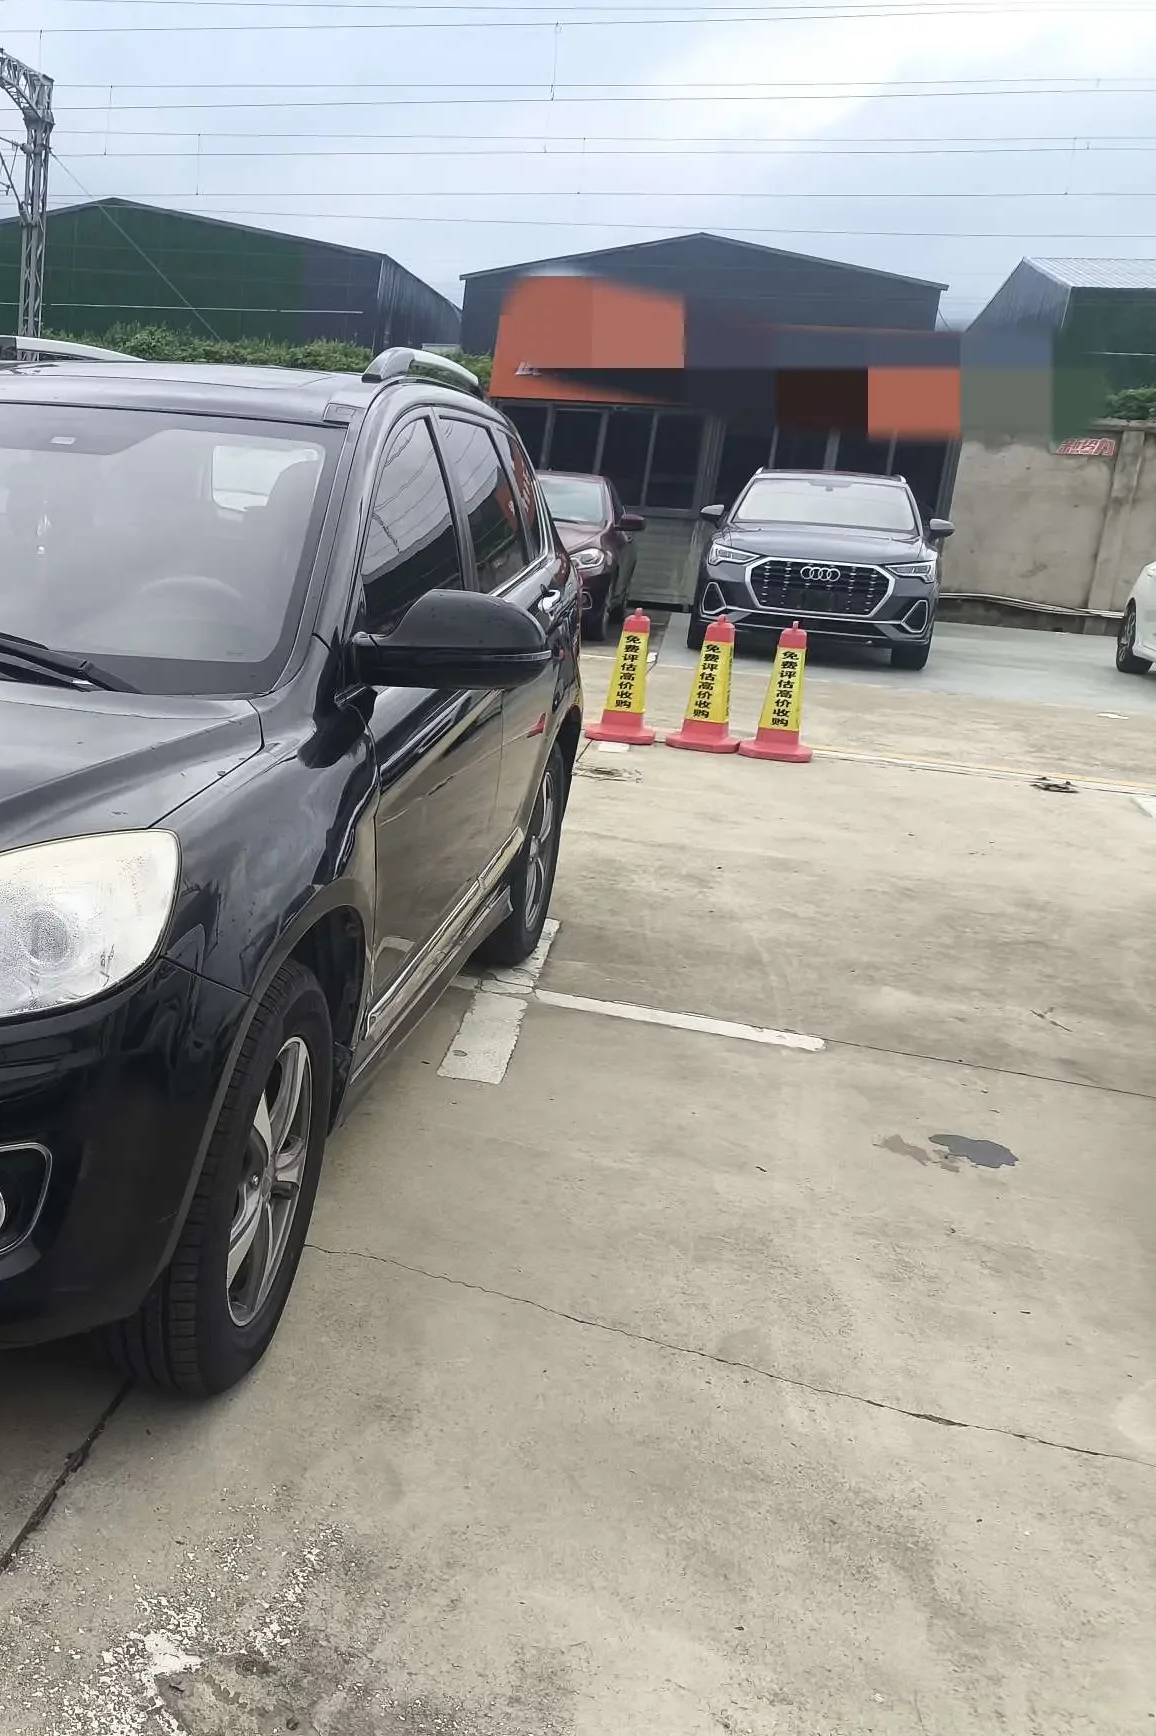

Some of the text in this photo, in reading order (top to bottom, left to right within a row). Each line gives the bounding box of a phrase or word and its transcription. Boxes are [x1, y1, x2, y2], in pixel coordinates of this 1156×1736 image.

[615, 634, 642, 709] 免费评估高价收购
[693, 644, 722, 719] 免费评估高价收购
[771, 651, 799, 727] 免费评估高价收购
